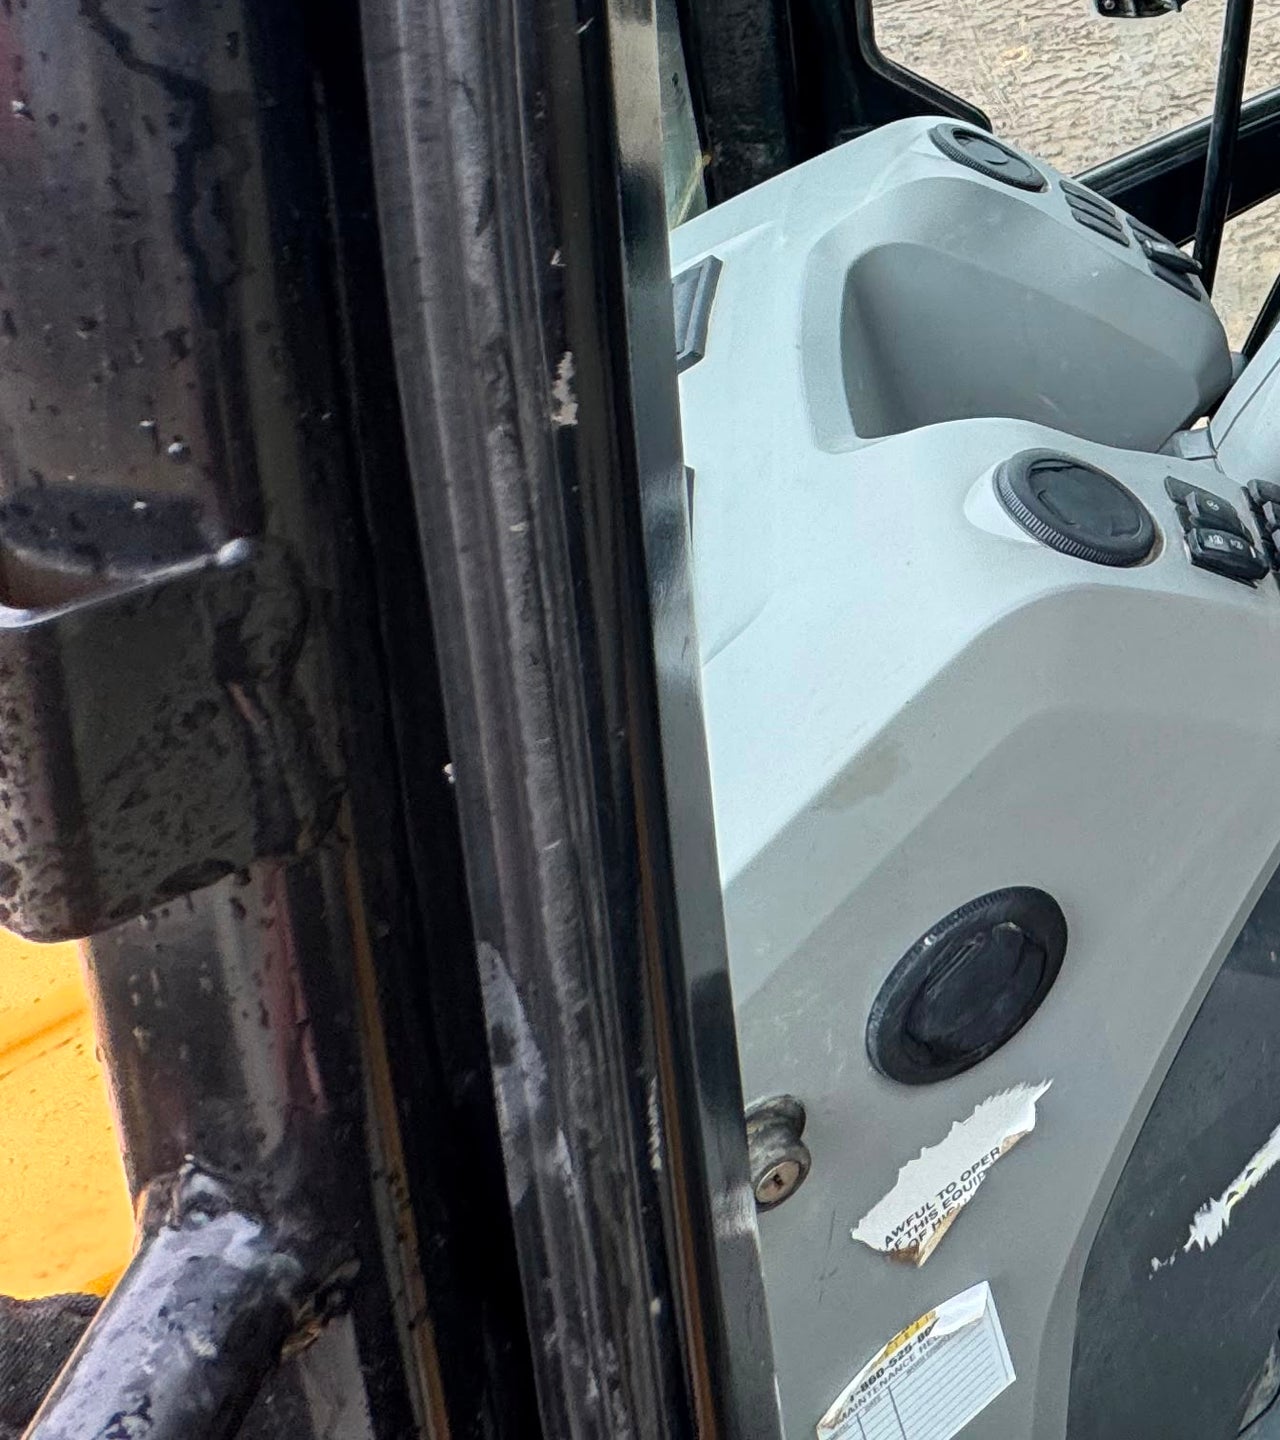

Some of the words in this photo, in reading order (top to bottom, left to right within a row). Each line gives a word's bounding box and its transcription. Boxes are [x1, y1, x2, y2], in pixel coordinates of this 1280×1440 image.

[884, 1202, 936, 1247] AWFUL
[935, 1182, 957, 1200] TO
[904, 1209, 939, 1239] THIS
